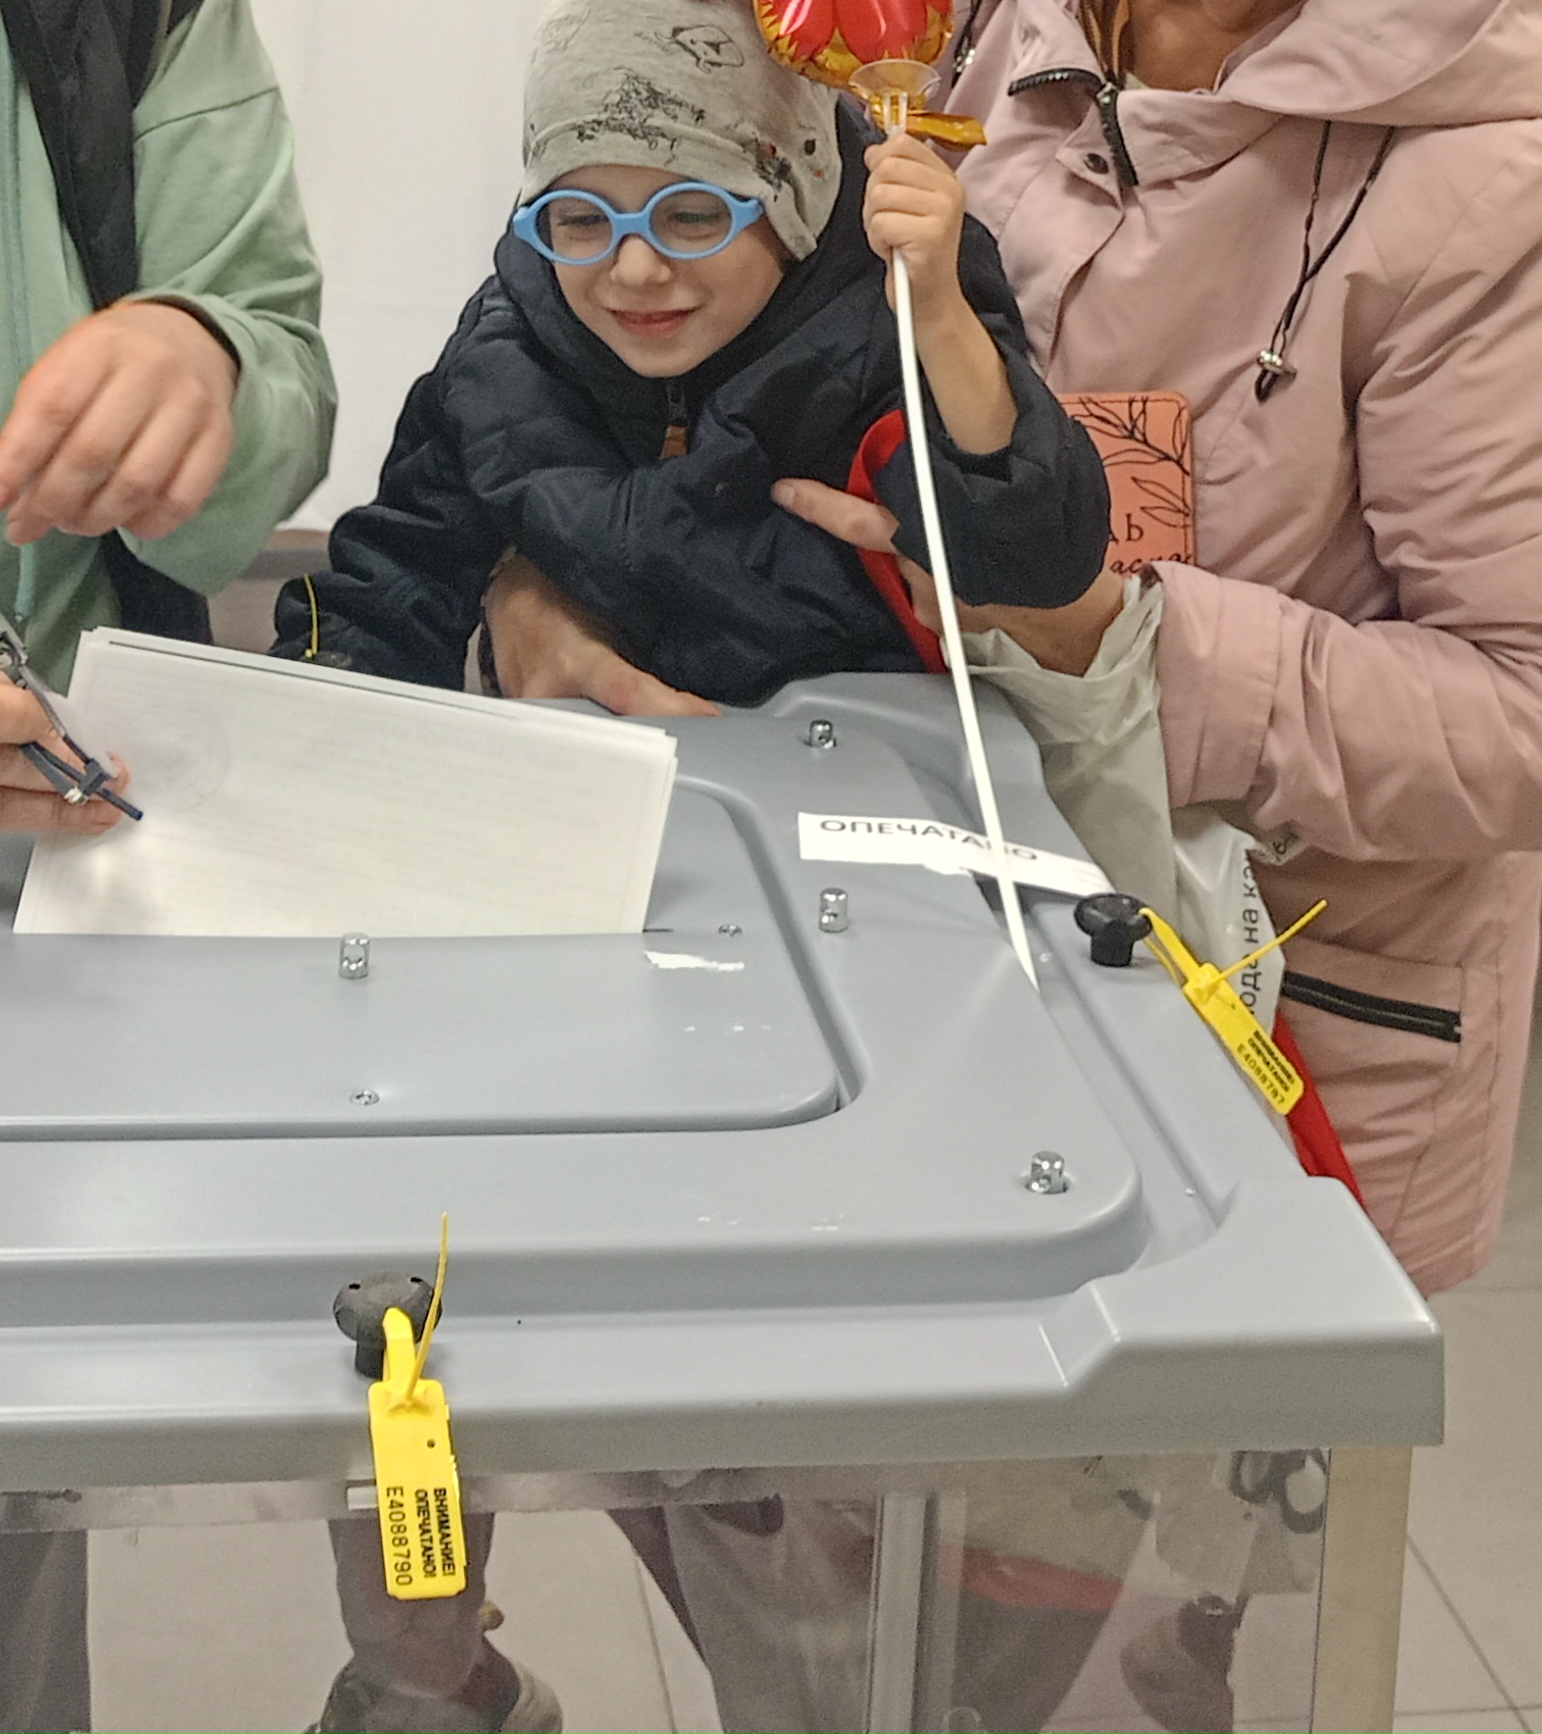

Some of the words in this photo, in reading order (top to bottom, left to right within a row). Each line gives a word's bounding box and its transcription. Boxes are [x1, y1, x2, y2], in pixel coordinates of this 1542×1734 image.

[819, 819, 1038, 861] ОПЕЧАТАО
[1242, 908, 1260, 945] на
[386, 1486, 413, 1587] E4088790
